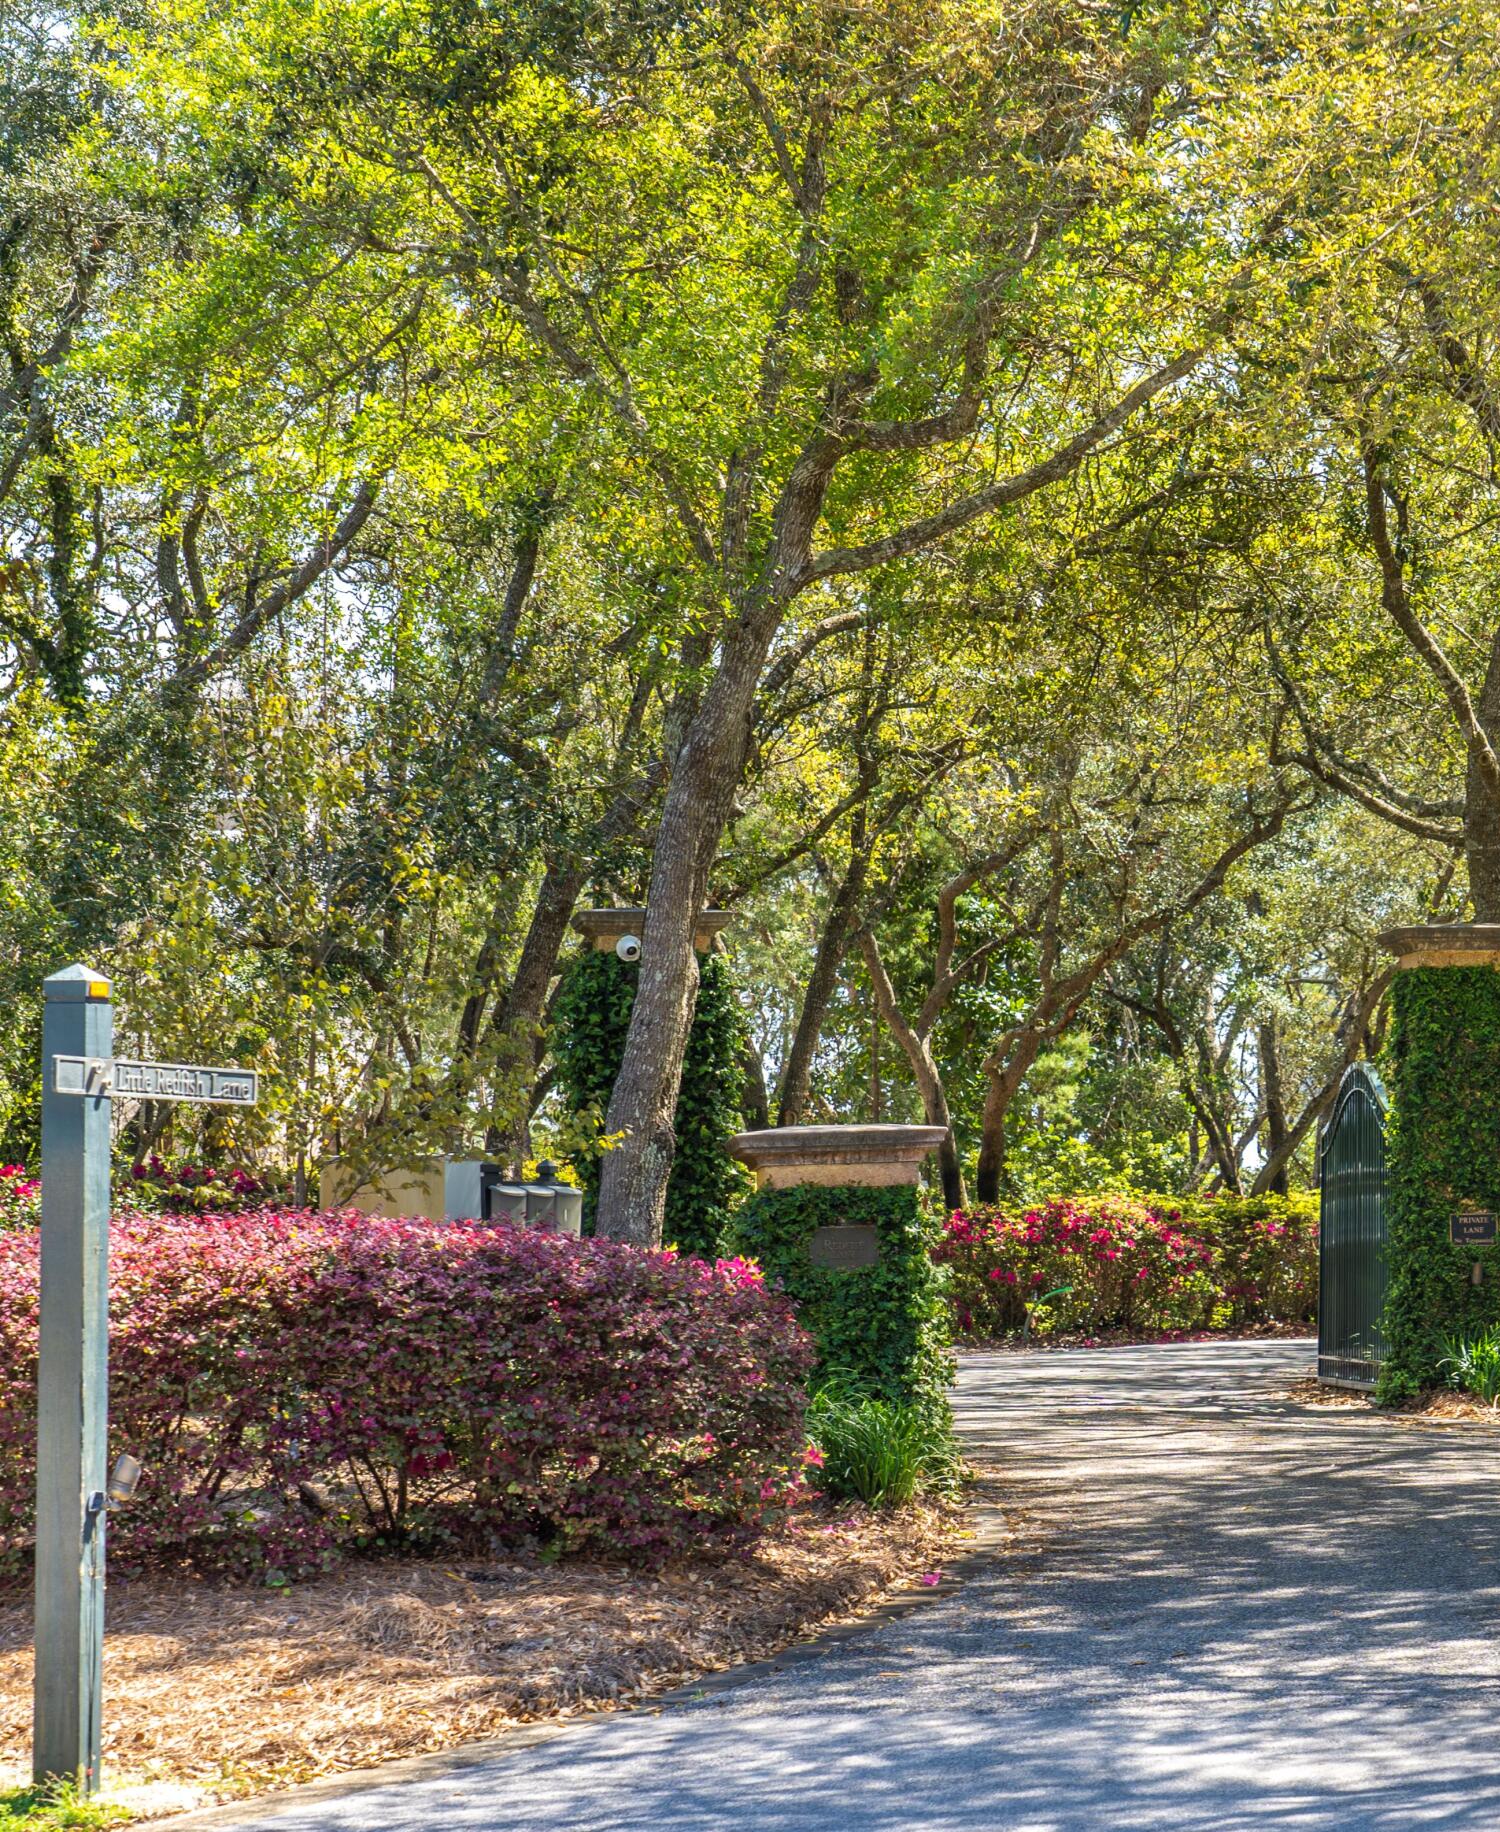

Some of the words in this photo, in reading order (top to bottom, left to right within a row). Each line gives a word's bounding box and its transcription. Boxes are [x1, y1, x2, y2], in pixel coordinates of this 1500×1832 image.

[117, 1065, 152, 1092] Little
[154, 1068, 204, 1097] Redfish
[210, 1073, 251, 1099] Lane
[1459, 1216, 1489, 1224] PRIVATE
[1463, 1226, 1485, 1234] LANE
